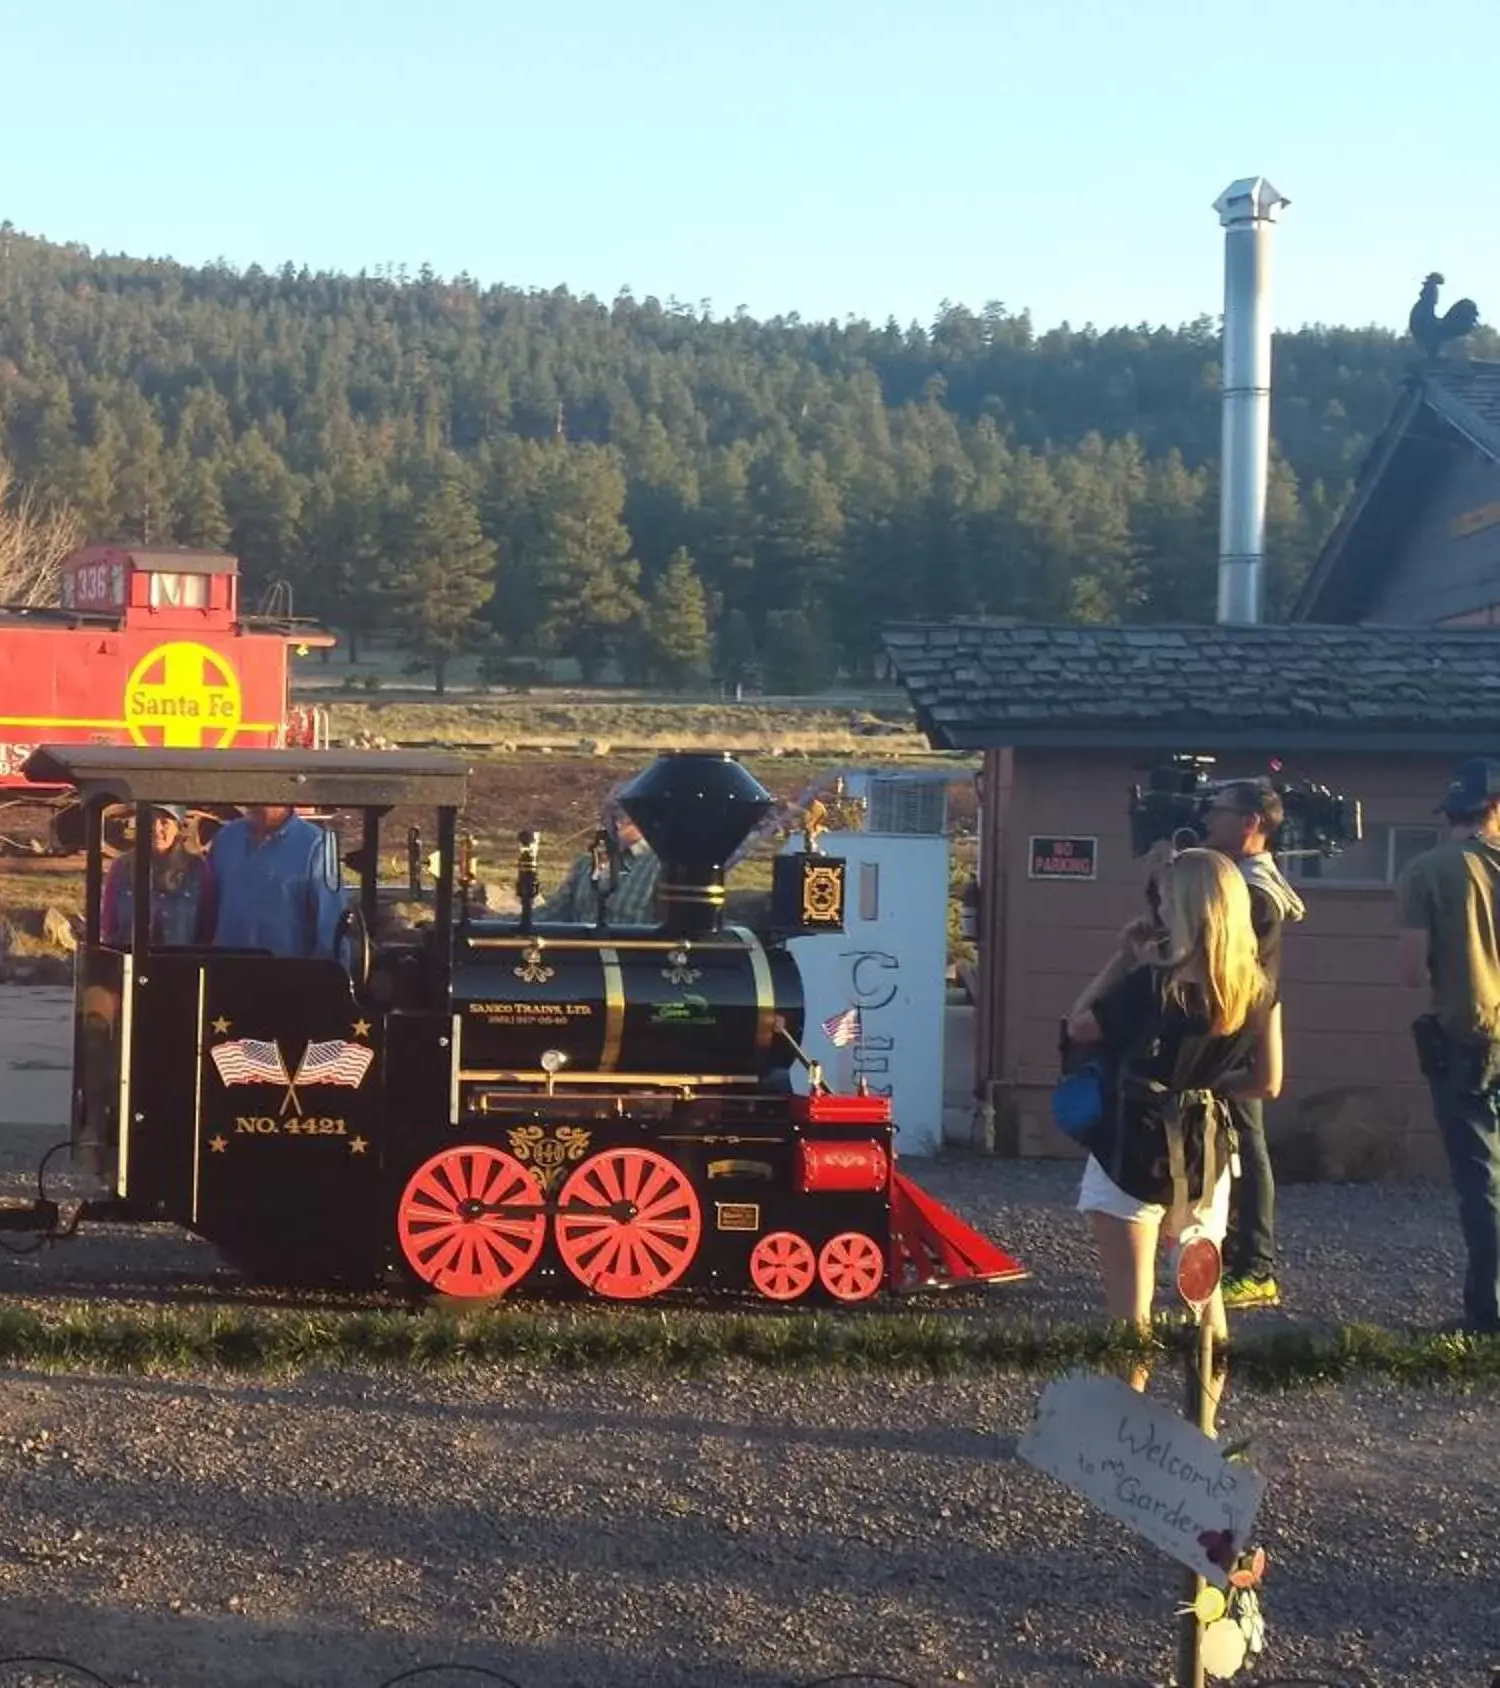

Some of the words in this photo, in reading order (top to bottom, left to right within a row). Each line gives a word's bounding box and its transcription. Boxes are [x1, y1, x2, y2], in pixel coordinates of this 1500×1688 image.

[131, 691, 200, 717] Santa
[208, 693, 235, 717] Fe
[1053, 841, 1074, 857] NO
[1035, 856, 1091, 873] PARKING
[234, 1117, 279, 1133] NO.
[284, 1117, 348, 1135] 4421
[1078, 1453, 1095, 1474] to
[1101, 1457, 1125, 1478] my
[1117, 1414, 1237, 1499] Welcome
